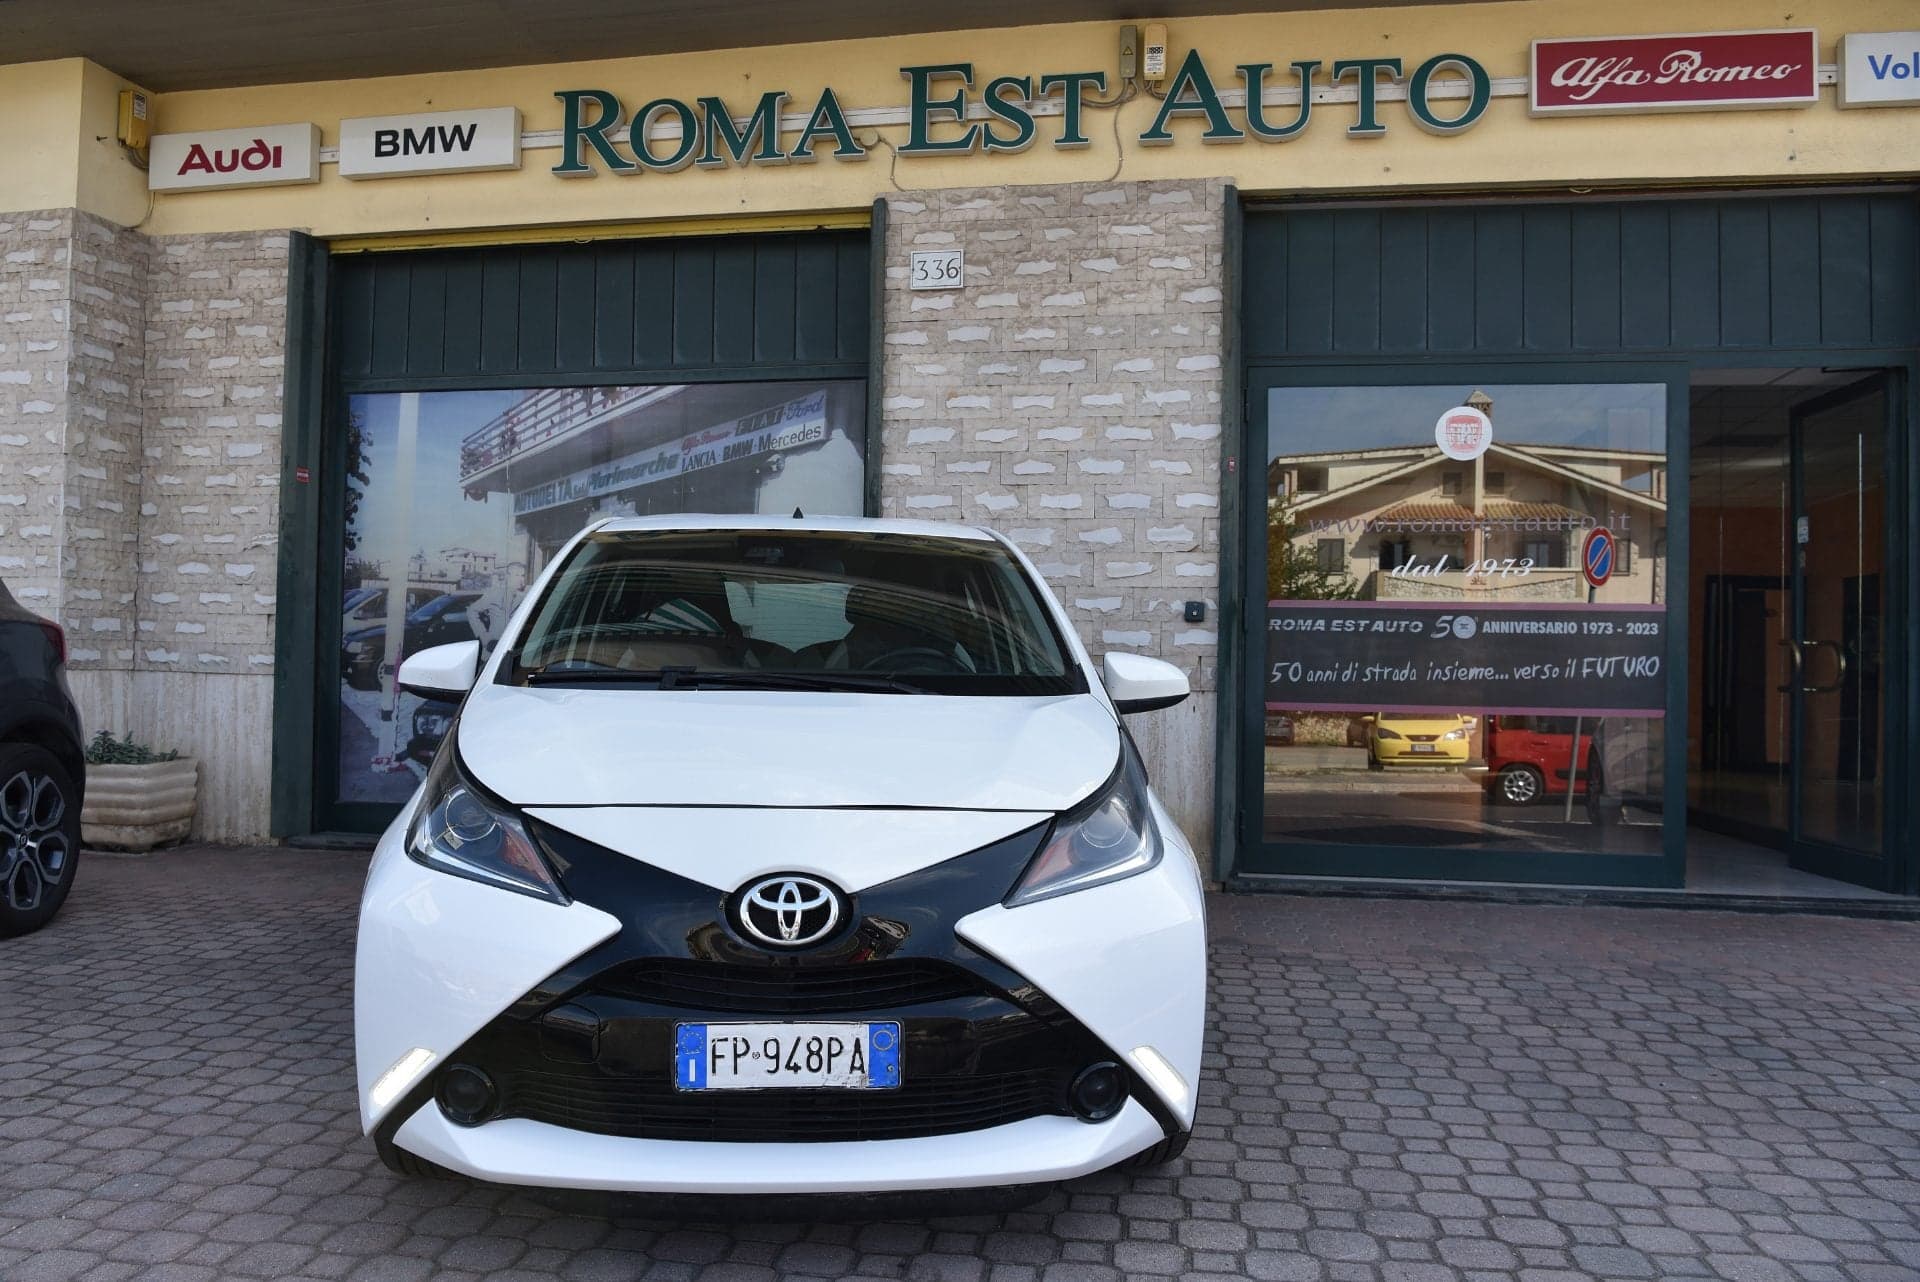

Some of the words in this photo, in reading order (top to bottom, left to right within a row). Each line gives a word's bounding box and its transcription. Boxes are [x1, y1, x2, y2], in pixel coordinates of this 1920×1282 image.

[1550, 56, 1652, 101] Alfa
[1653, 49, 1801, 86] Romeo
[1868, 51, 1920, 80] Vol
[551, 87, 867, 177] ROMA
[897, 63, 1107, 154] EST
[1137, 48, 1492, 144] AUTO
[374, 123, 477, 158] BMW
[177, 138, 282, 176] Audi
[914, 257, 960, 281] 336
[786, 395, 825, 420] Ford
[682, 449, 717, 472] LANCIA
[722, 438, 754, 460] BMW
[758, 423, 822, 451] Mercedes
[1308, 510, 1632, 534] www.romaestauto.it
[1391, 554, 1449, 578] dal
[1462, 557, 1534, 578] 1973
[1267, 618, 1326, 632] ROMA
[1330, 619, 1370, 632] EST
[1371, 620, 1424, 633] AUTO
[1482, 621, 1578, 634] ANNIVERSARIO
[1582, 622, 1613, 634] 1973
[1626, 622, 1659, 635] 2023
[1270, 661, 1302, 683] 50
[1306, 662, 1339, 682] anni
[1341, 661, 1359, 682] di
[1362, 661, 1417, 682] strada
[1513, 663, 1560, 680] verso
[1565, 658, 1577, 679] il
[1582, 655, 1660, 679] FUTURO
